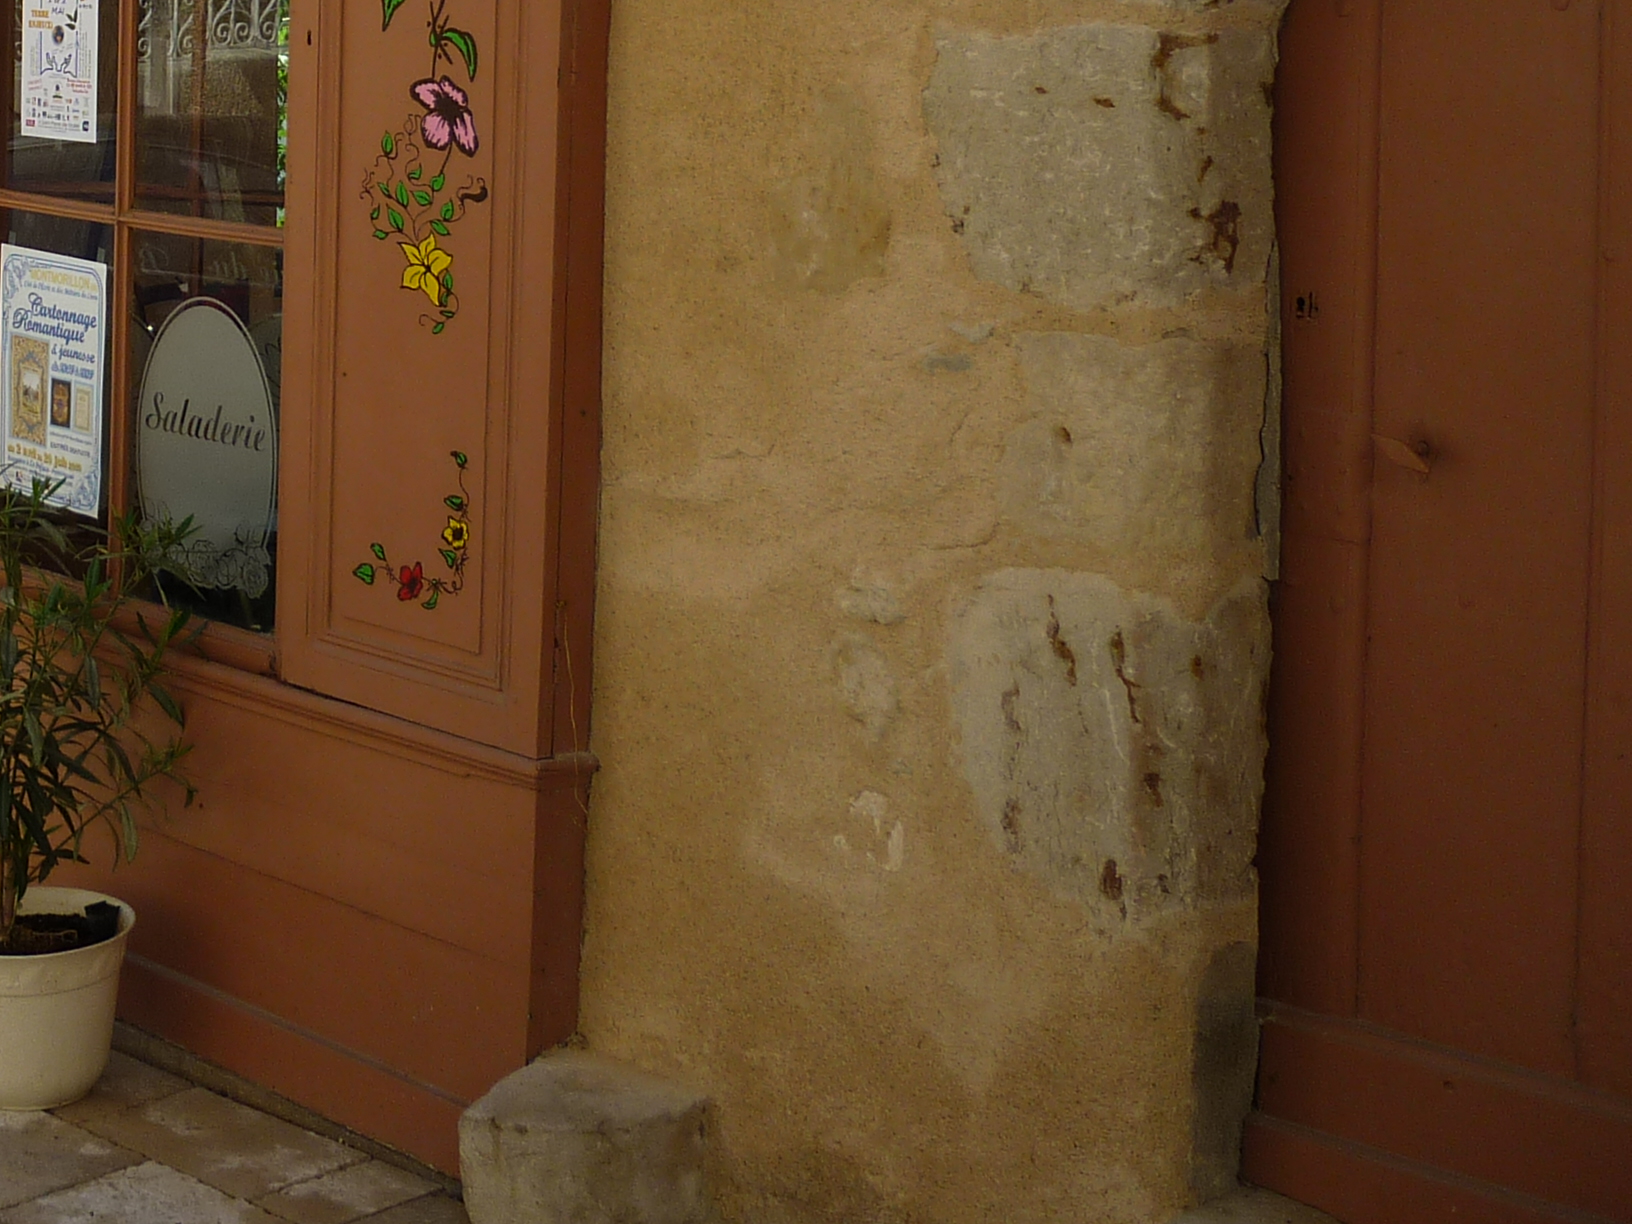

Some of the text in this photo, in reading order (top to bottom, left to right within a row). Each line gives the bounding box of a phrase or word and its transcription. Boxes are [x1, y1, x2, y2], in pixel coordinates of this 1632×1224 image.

[12, 307, 85, 345] Romantique
[28, 292, 97, 332] Cartonnage
[58, 344, 95, 364] jeunesse
[145, 390, 266, 453] Saladerie
